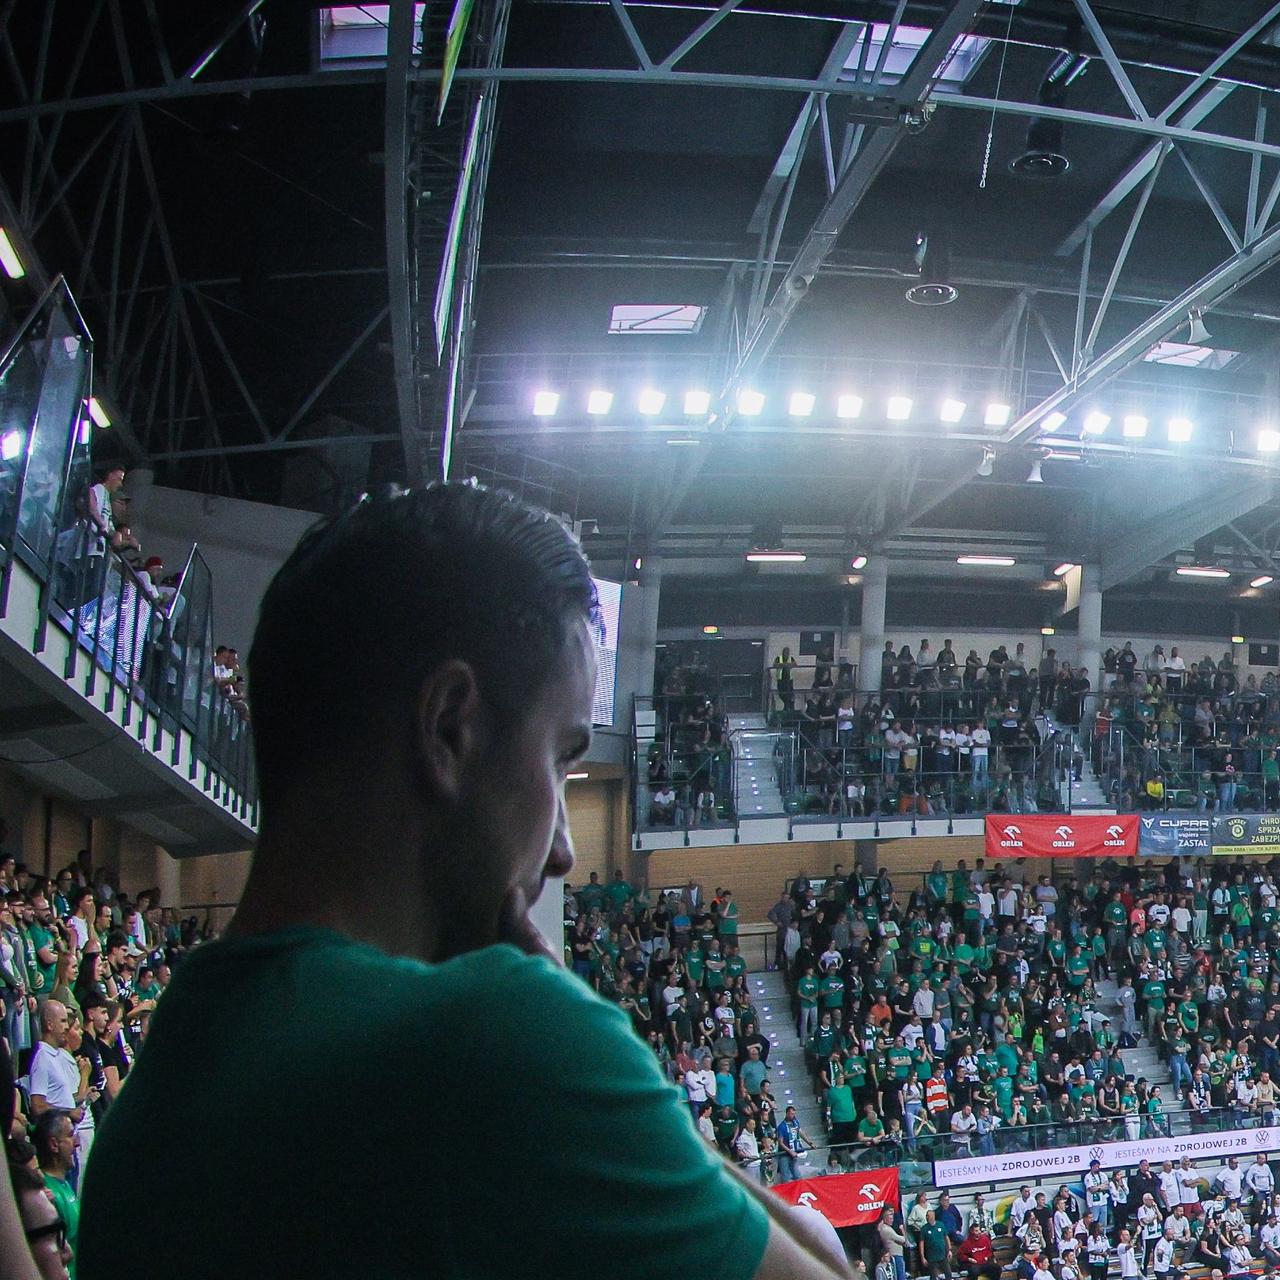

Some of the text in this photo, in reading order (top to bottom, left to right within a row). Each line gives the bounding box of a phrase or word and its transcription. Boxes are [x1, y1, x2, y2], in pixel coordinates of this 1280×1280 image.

[1052, 840, 1075, 848] ORLEN
[1178, 839, 1209, 847] ZASTAL
[1114, 1146, 1155, 1158] JESTEŚMY
[1157, 1145, 1171, 1154] NA
[1174, 1138, 1234, 1152] ZDROJOWEJ
[938, 1154, 1081, 1178] JESTEŚMY NA ZDROJOWEJ 2B
[857, 1200, 884, 1211] ORLEN
